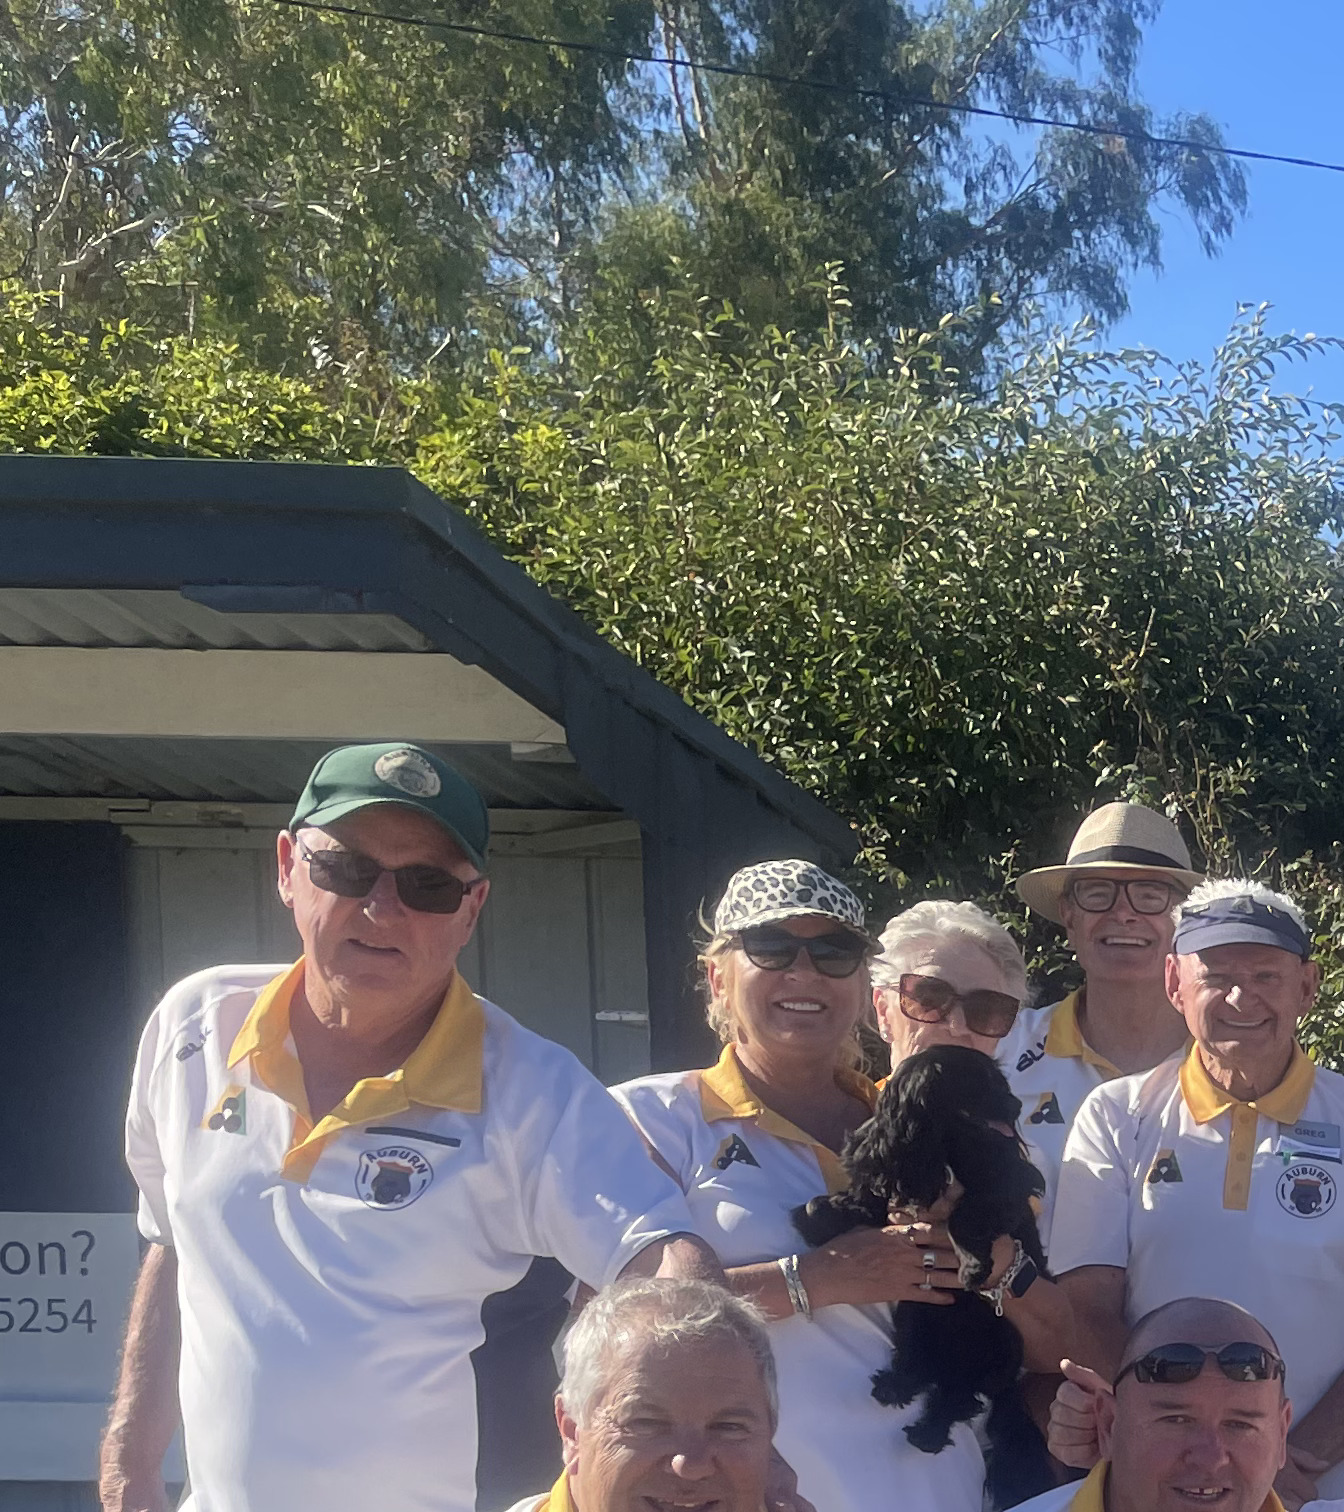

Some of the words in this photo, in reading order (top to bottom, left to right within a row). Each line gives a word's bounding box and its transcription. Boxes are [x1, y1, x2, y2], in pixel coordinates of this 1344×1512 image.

[1295, 1128, 1326, 1138] GREG
[366, 1149, 429, 1175] AUBURN
[1285, 1167, 1331, 1185] AUBURN
[0, 1230, 96, 1276] on?
